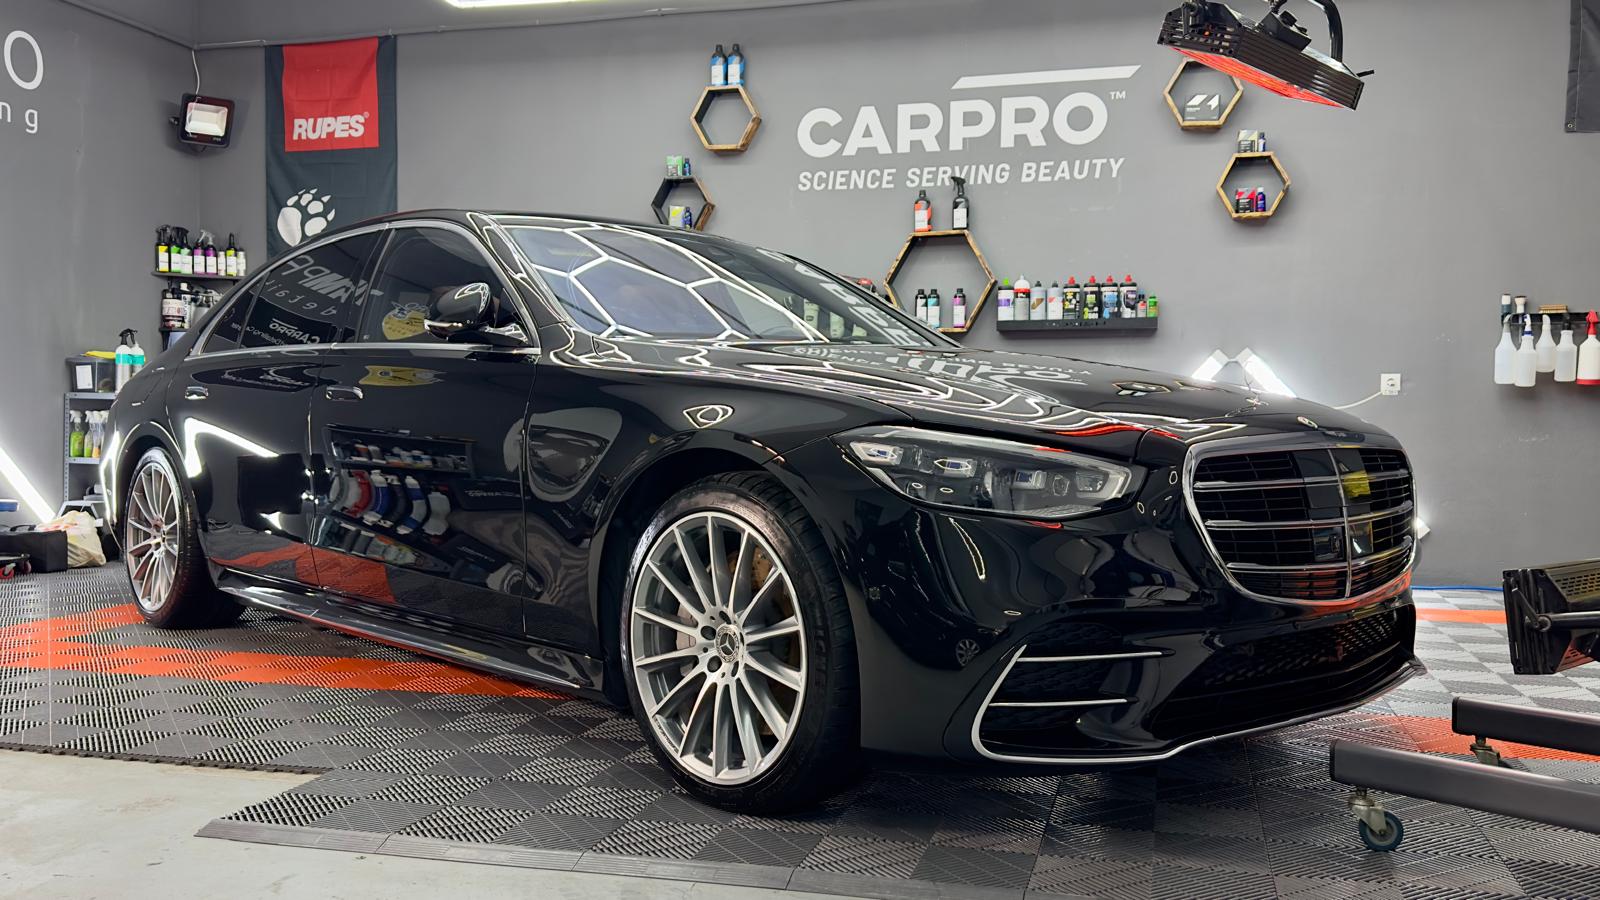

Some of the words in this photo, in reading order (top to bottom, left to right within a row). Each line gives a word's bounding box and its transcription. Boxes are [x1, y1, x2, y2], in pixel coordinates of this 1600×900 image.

[4, 30, 43, 90] O
[293, 114, 365, 140] RUPES
[797, 92, 1108, 158] CARPRO
[798, 168, 897, 191] SCIENCE
[905, 163, 1010, 188] SERVING
[1021, 158, 1125, 183] BEAUTY
